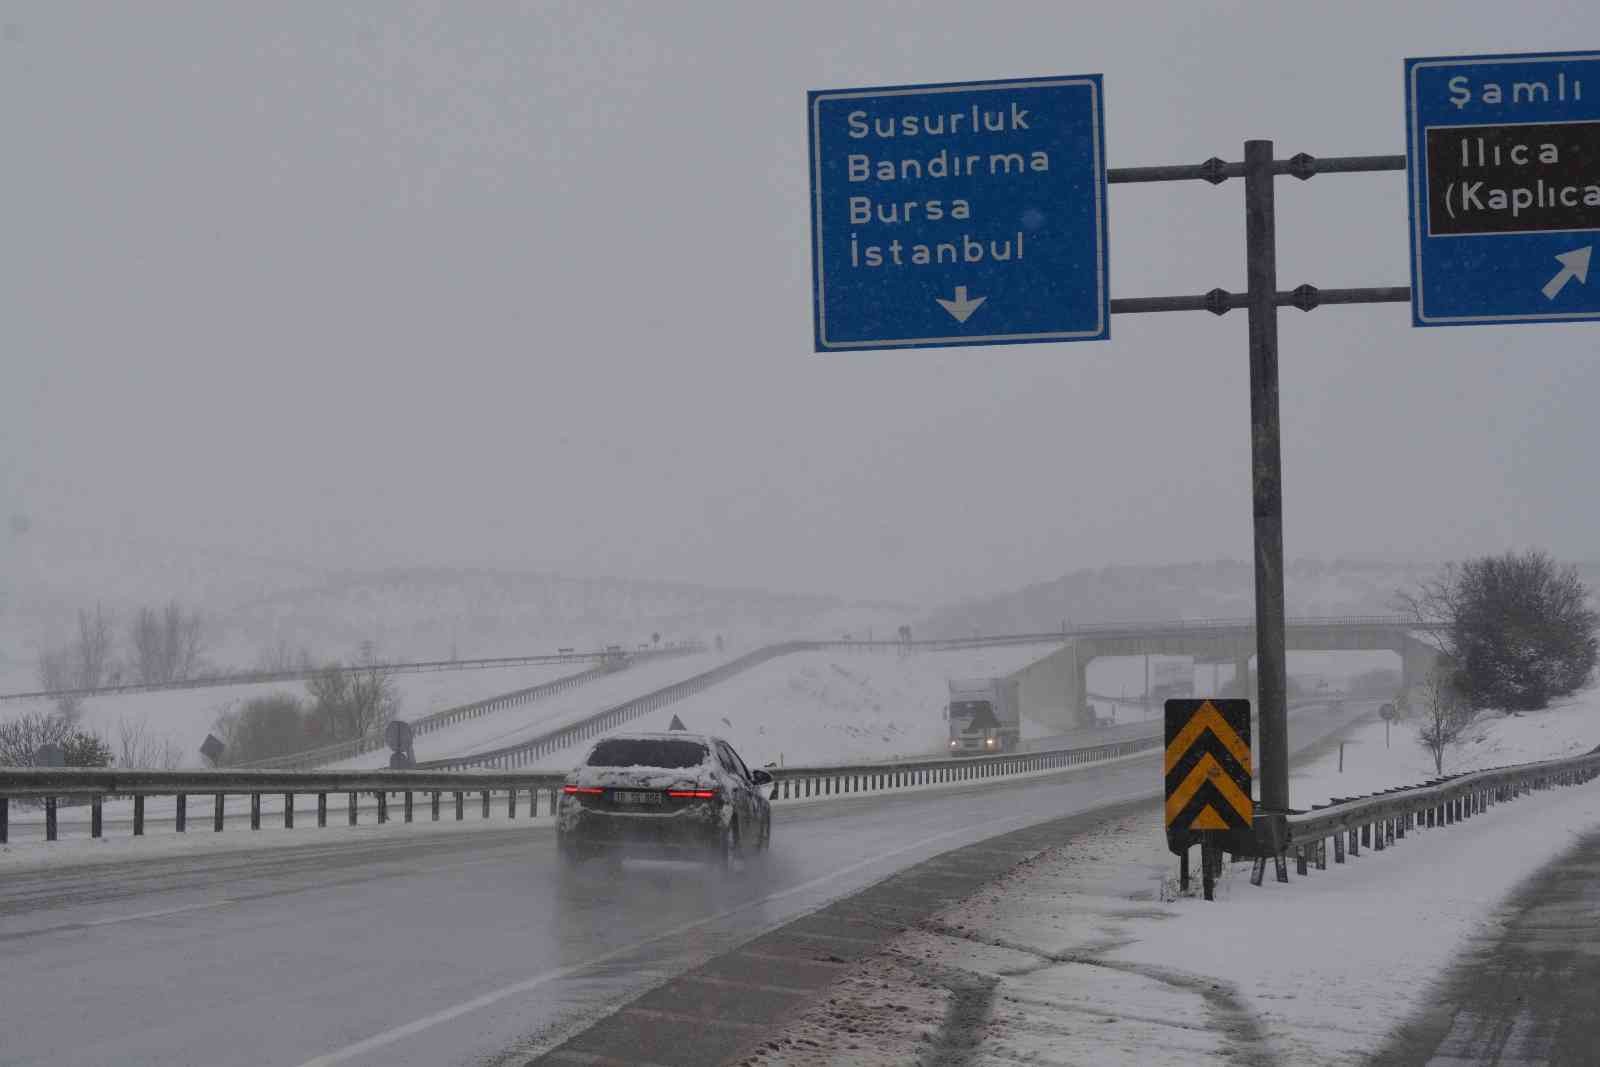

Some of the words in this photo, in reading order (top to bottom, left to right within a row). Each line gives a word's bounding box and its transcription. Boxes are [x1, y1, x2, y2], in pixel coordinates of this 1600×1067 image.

[1448, 73, 1582, 109] Şamlı
[848, 102, 1029, 138] Susurluk
[848, 149, 1049, 182] Bandırma
[850, 197, 970, 225] Bursa
[851, 231, 1023, 268] İstanbul
